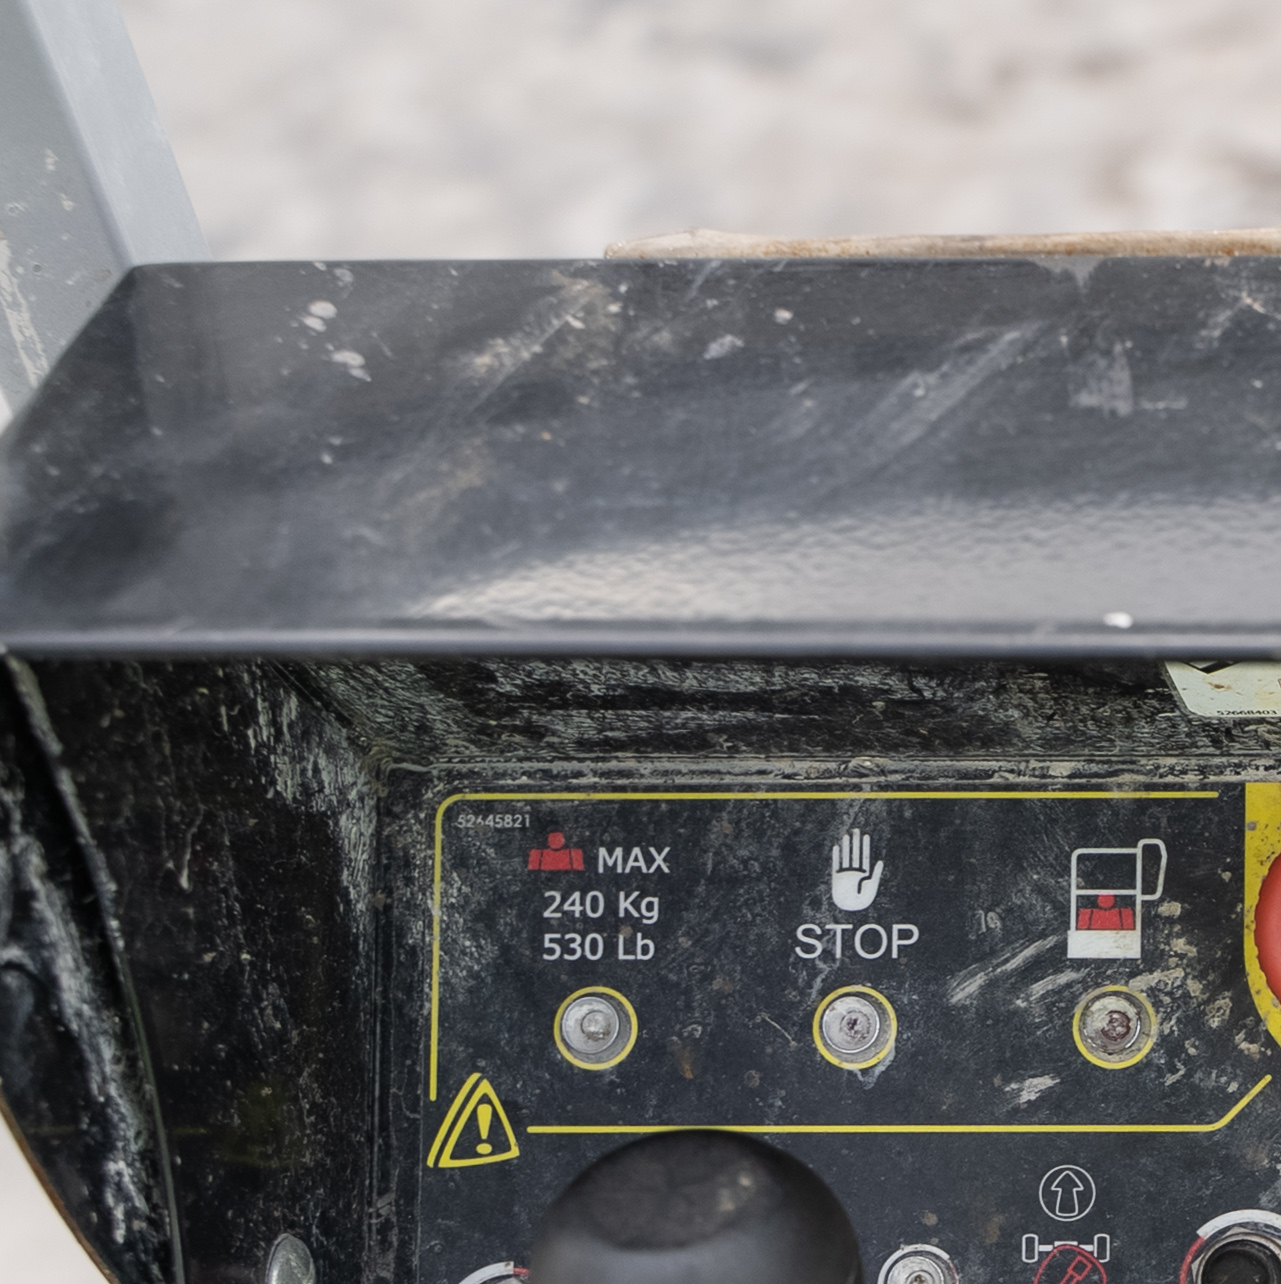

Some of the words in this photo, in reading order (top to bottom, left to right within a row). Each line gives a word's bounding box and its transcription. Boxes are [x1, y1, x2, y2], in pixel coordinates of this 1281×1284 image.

[598, 846, 672, 874] MAX
[543, 890, 605, 919] 240
[618, 890, 660, 925] Kg
[543, 932, 605, 961] 530
[618, 932, 656, 961] Lb
[795, 923, 920, 960] STOP
